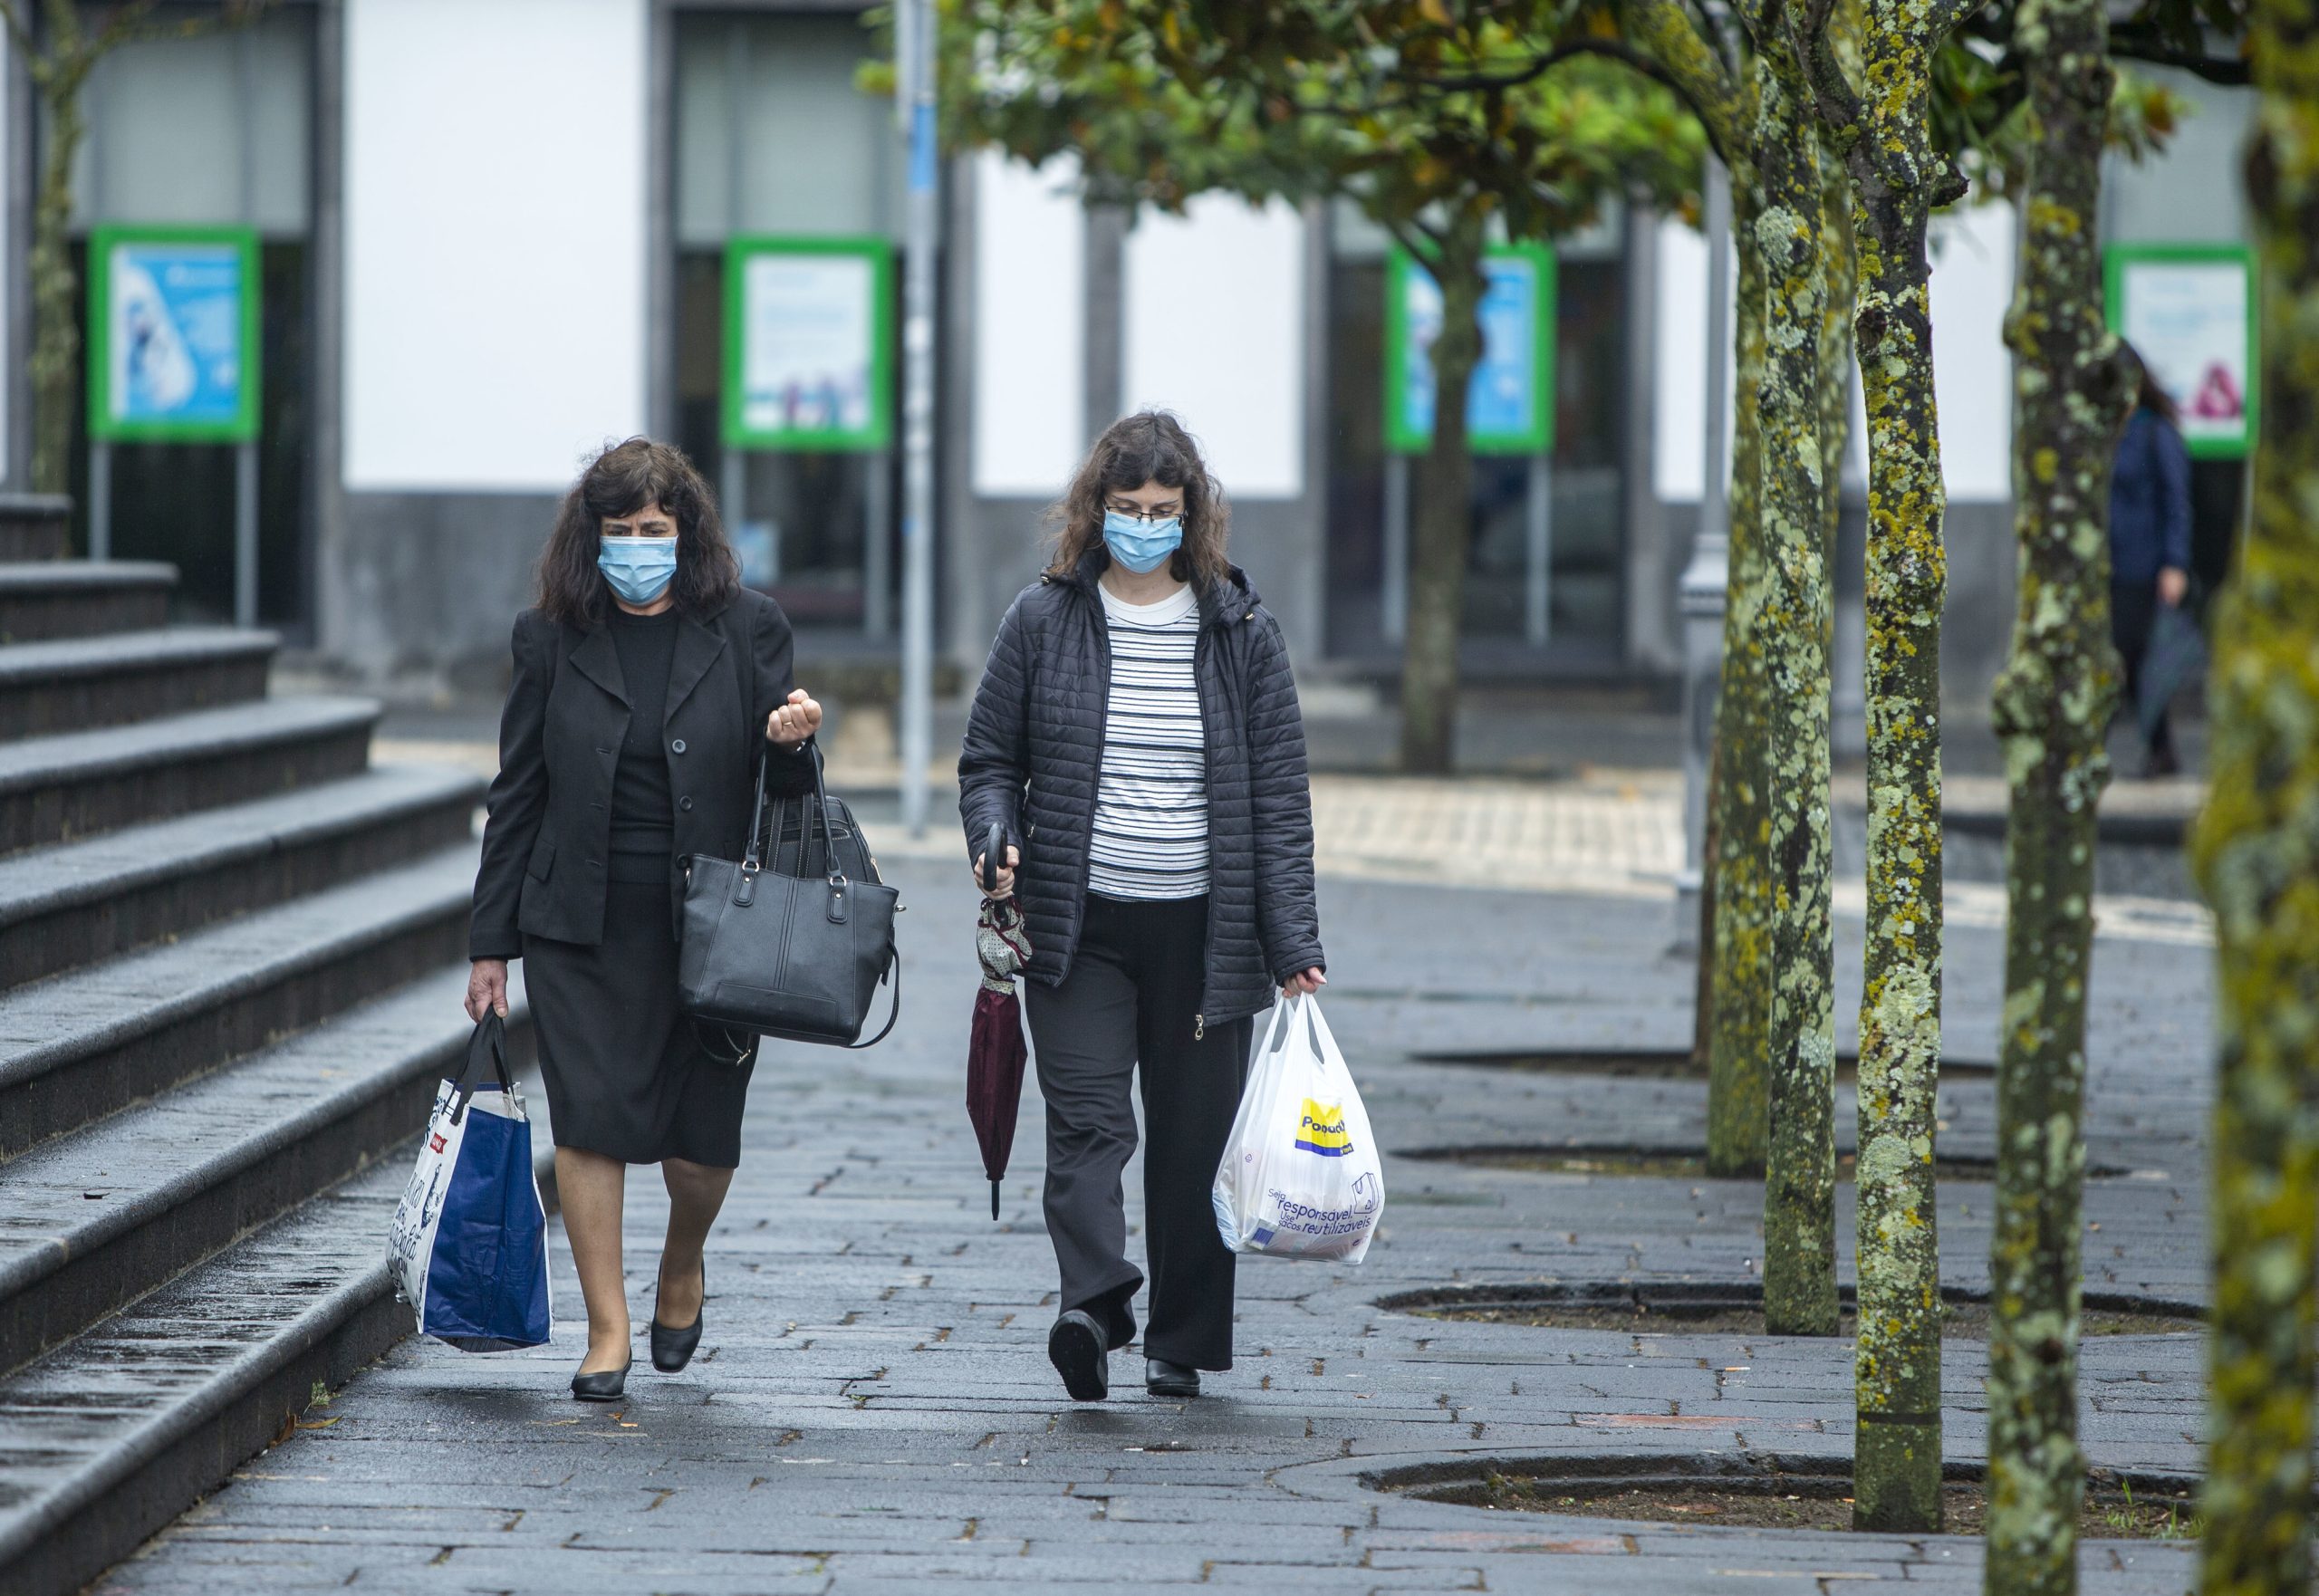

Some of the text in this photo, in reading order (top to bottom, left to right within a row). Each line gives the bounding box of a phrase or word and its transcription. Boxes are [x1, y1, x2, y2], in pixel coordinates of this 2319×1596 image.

[1268, 1188, 1286, 1200] Seja
[1277, 1199, 1353, 1221] responsável.
[1280, 1211, 1295, 1223] Use
[1278, 1219, 1301, 1231] sacos
